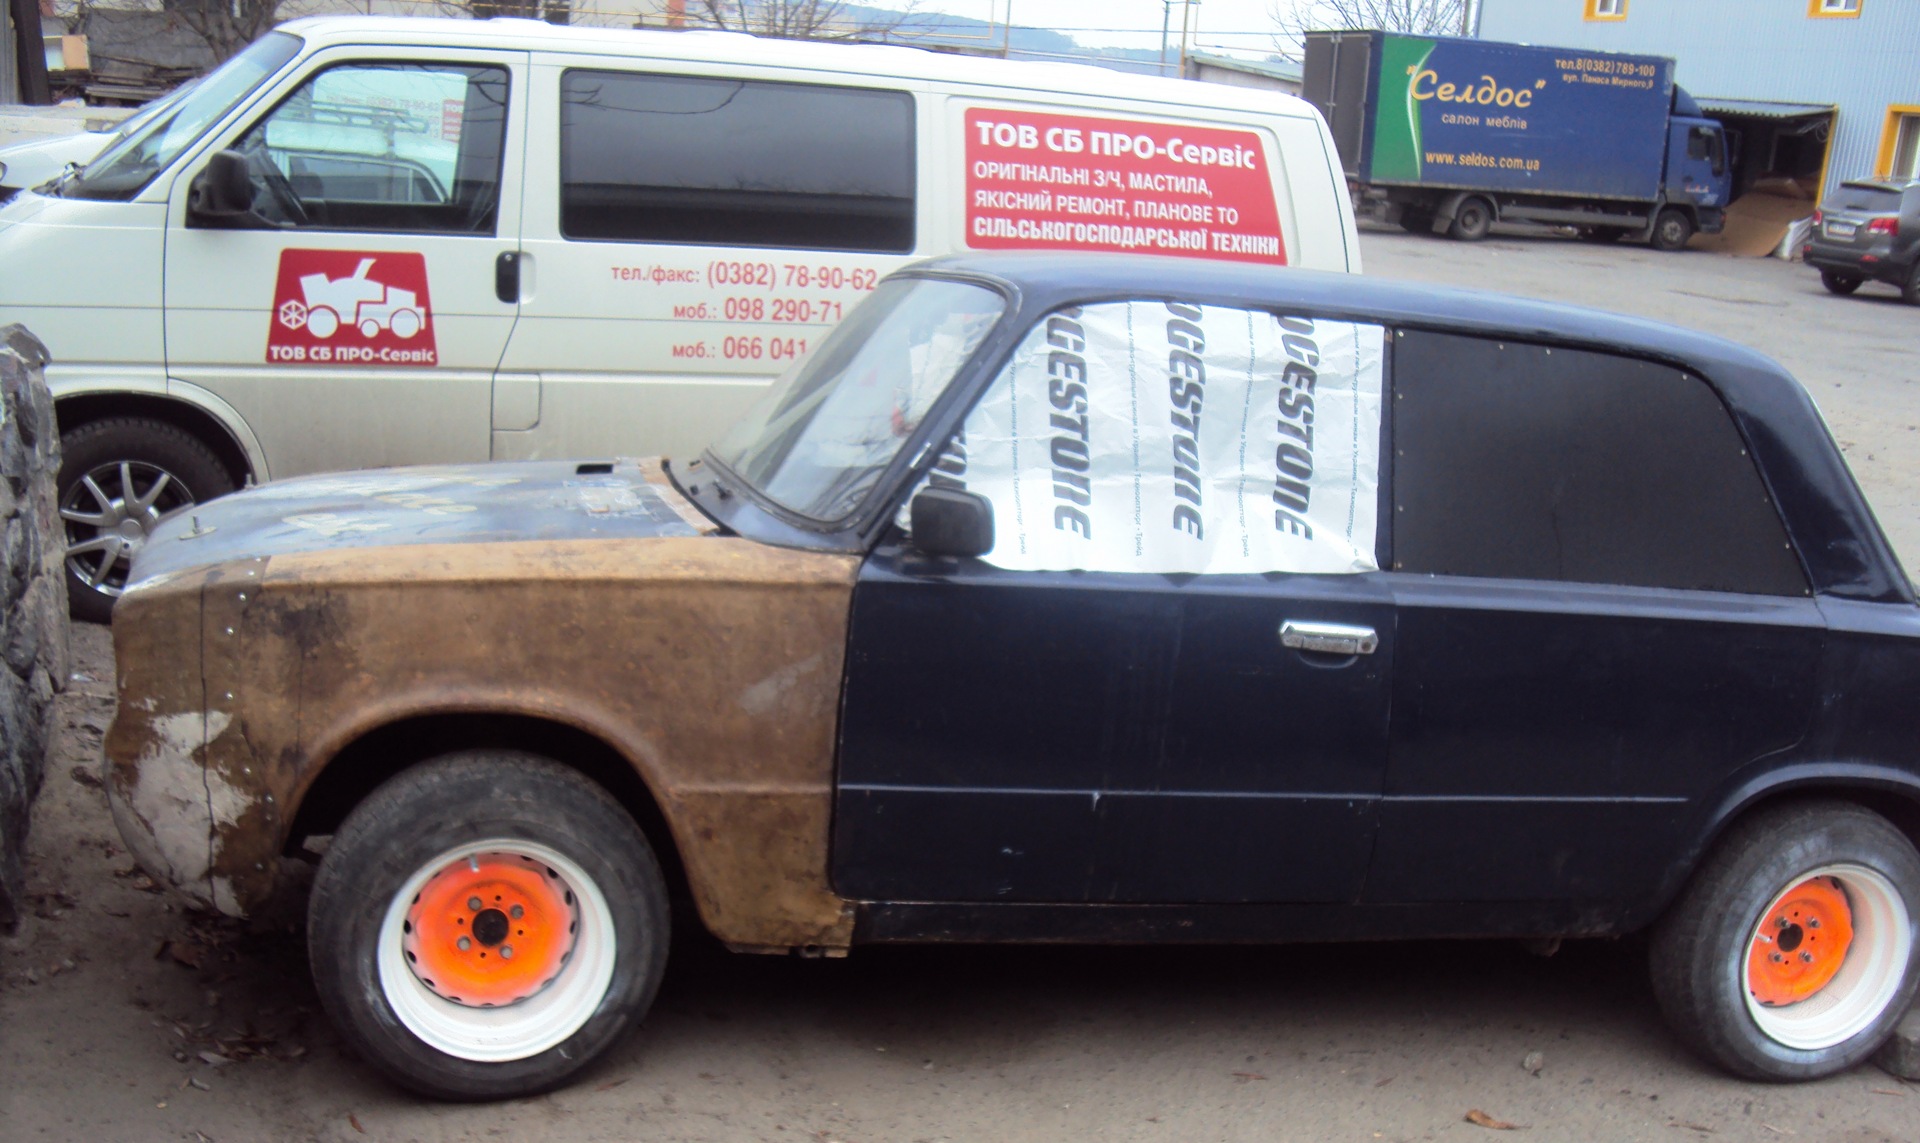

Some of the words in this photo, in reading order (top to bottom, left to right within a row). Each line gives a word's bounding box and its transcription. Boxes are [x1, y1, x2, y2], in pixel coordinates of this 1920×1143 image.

[1441, 113, 1479, 125] салон
[1486, 116, 1527, 130] меблів
[976, 121, 1039, 149] ТОВ
[1045, 127, 1084, 153] СБ
[1091, 132, 1256, 170] ПРО-Сервіс
[974, 161, 1089, 186] ОРИГІНАЛЬНІ
[1129, 172, 1213, 198] МАСТИЛА,
[974, 190, 1052, 211] ЯКІСНИЙ
[1056, 195, 1130, 219] РЕМОНТ,
[1134, 200, 1214, 224] ПЛАНОВЕ
[1216, 207, 1239, 225] ТО
[973, 216, 1207, 250] СІЛЬСЬКОГОСПОДАРСЬКОЇ
[1212, 232, 1279, 256] ТЕХНІКИ
[708, 261, 776, 291] (0382)
[783, 264, 877, 291] 78-90-62
[673, 303, 717, 320] моб.:
[724, 297, 764, 321] 098
[771, 299, 843, 322] 290-71
[271, 345, 305, 360] ТОВ
[309, 346, 332, 361] СБ
[336, 346, 434, 363] ПРО-Сервіс
[672, 342, 716, 359] моб.:
[723, 336, 763, 360] 066
